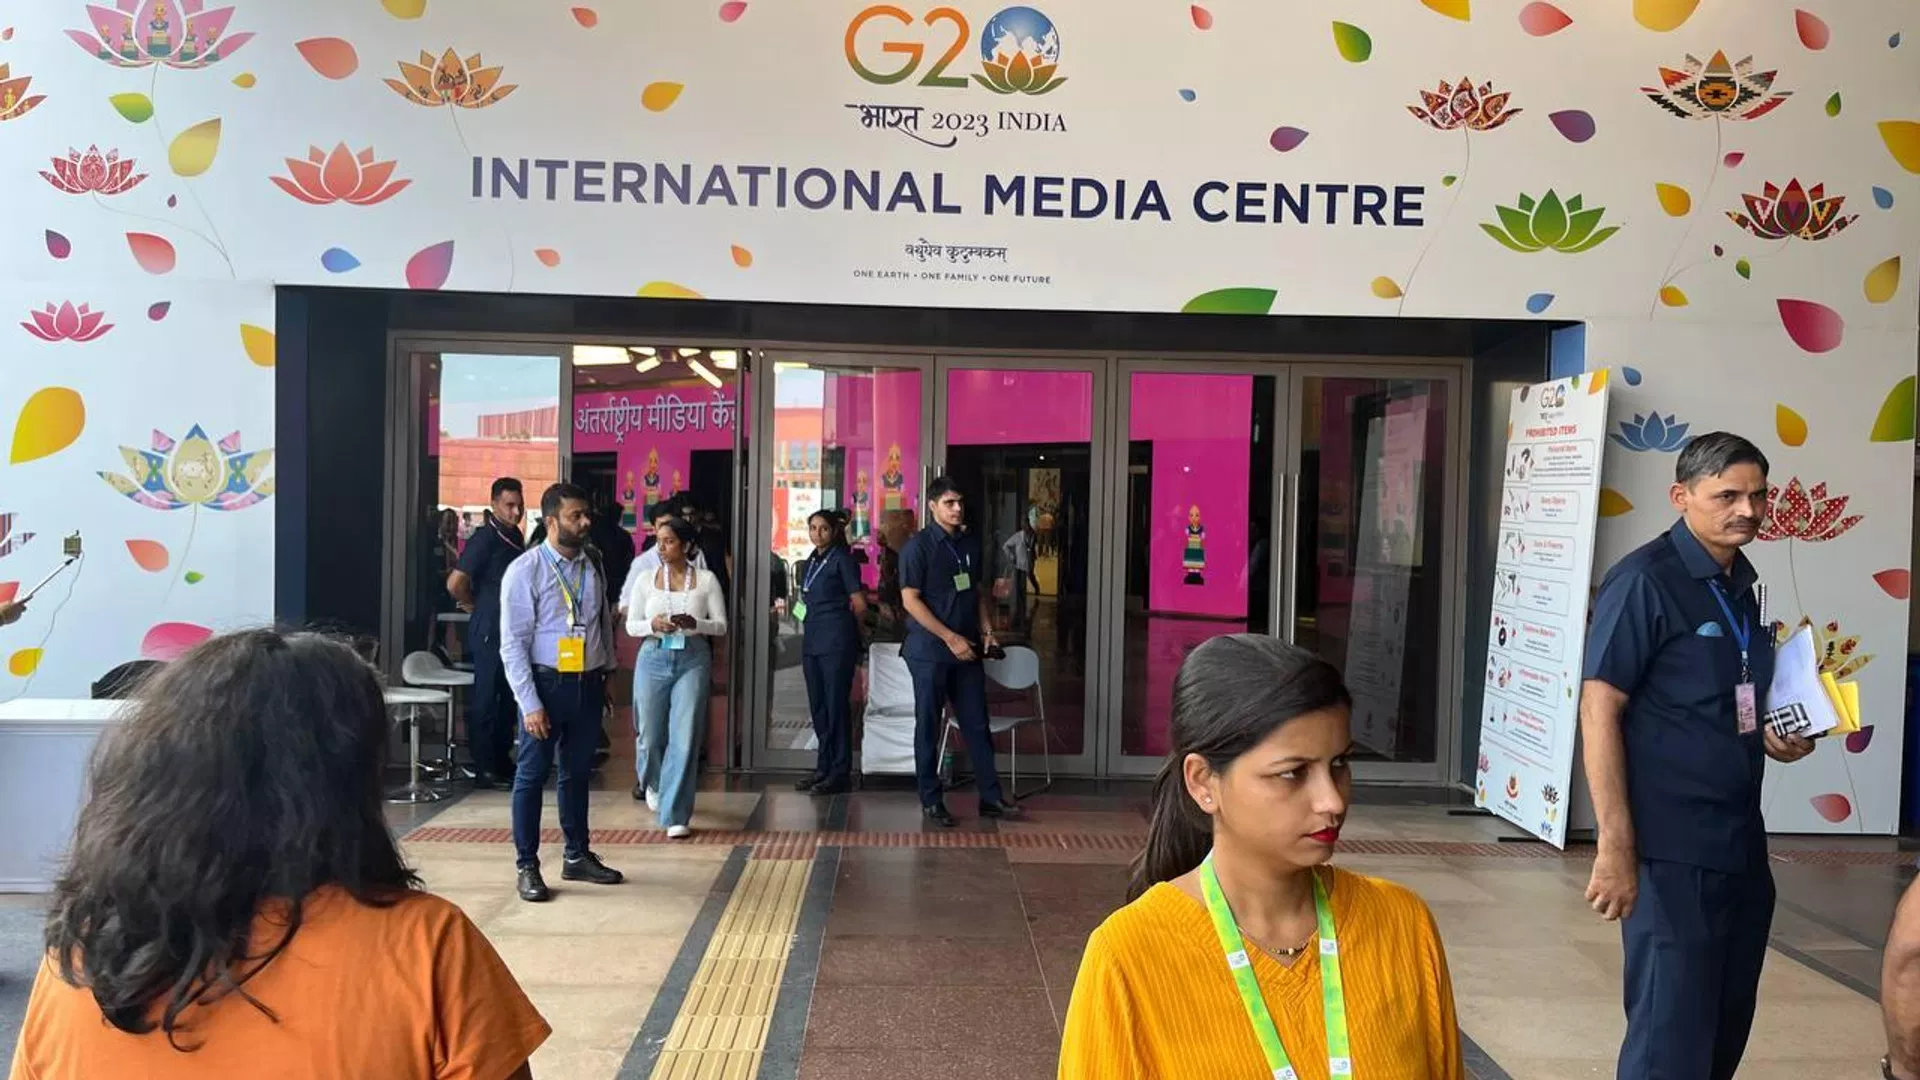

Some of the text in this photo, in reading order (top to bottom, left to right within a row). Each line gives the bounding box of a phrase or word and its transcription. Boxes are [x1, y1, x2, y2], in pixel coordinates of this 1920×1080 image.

[845, 5, 1068, 95] G20
[844, 104, 957, 148] भारत
[931, 110, 1067, 137] 2023 INDIA
[472, 156, 1426, 227] INTERNATIONAL MEDIA CENTRE
[853, 269, 1051, 284] ONE EARTH ONE FAMILY ONE FUTURE
[647, 394, 707, 432] मीडिया
